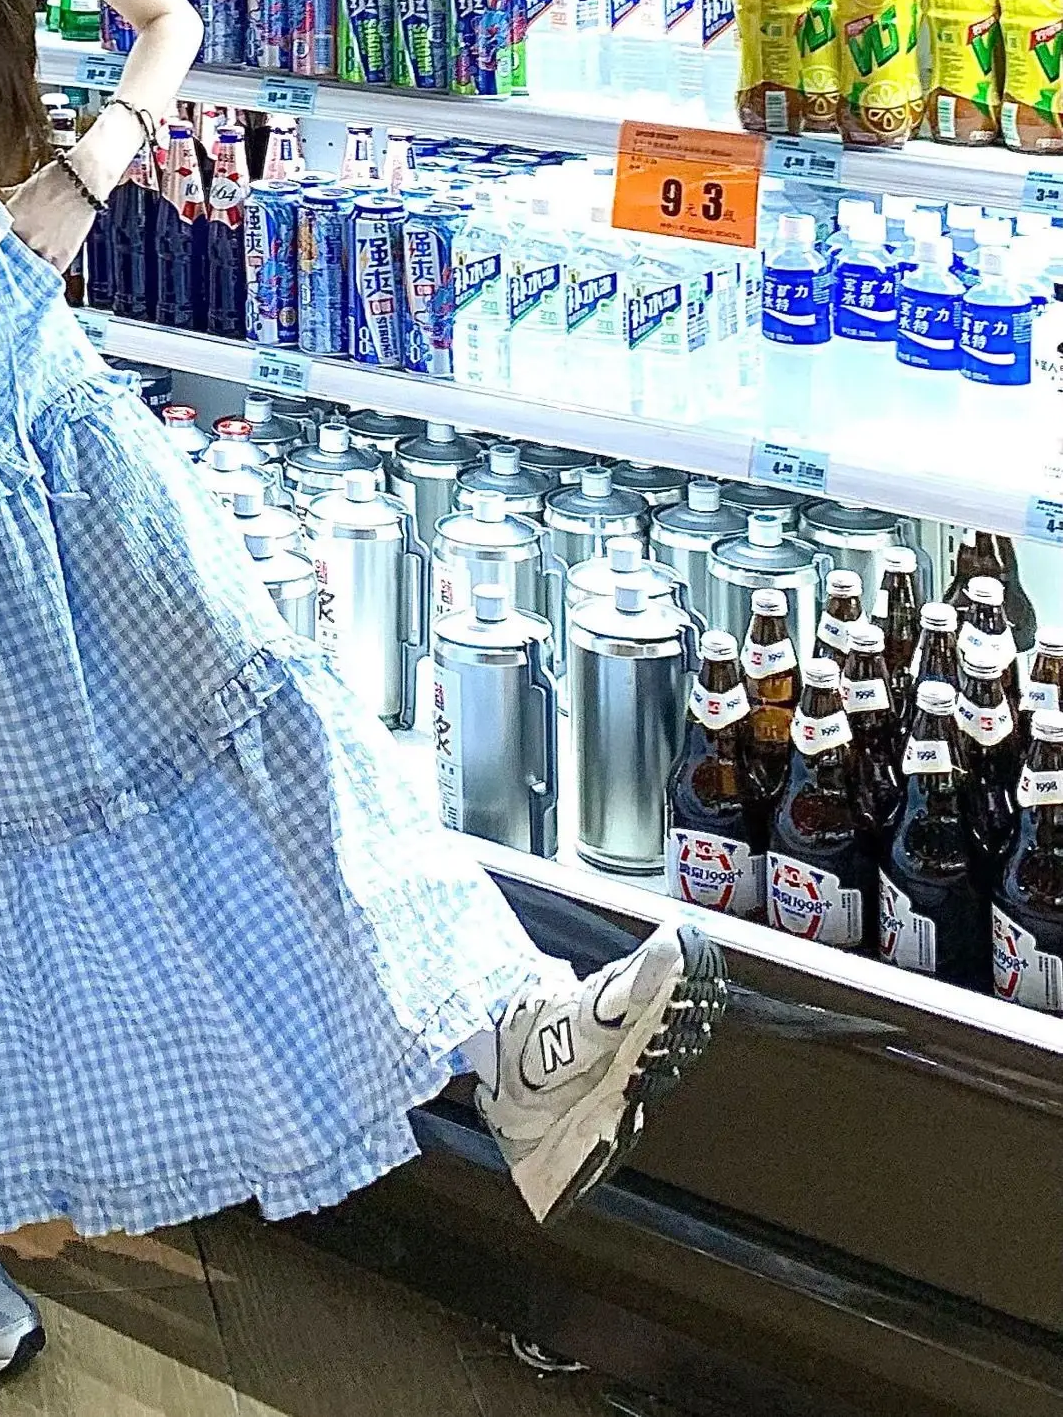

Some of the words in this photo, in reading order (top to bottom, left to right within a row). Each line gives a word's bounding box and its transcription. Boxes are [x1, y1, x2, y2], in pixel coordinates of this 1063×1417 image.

[660, 179, 683, 218] 9
[701, 182, 724, 221] 3
[357, 237, 394, 299] 强爽
[406, 231, 435, 284] 强爽
[841, 291, 876, 309] 水特
[842, 277, 894, 295] 宝矿力
[898, 316, 930, 335] 水特
[900, 301, 950, 323] 宝矿力
[539, 1016, 575, 1074] N
